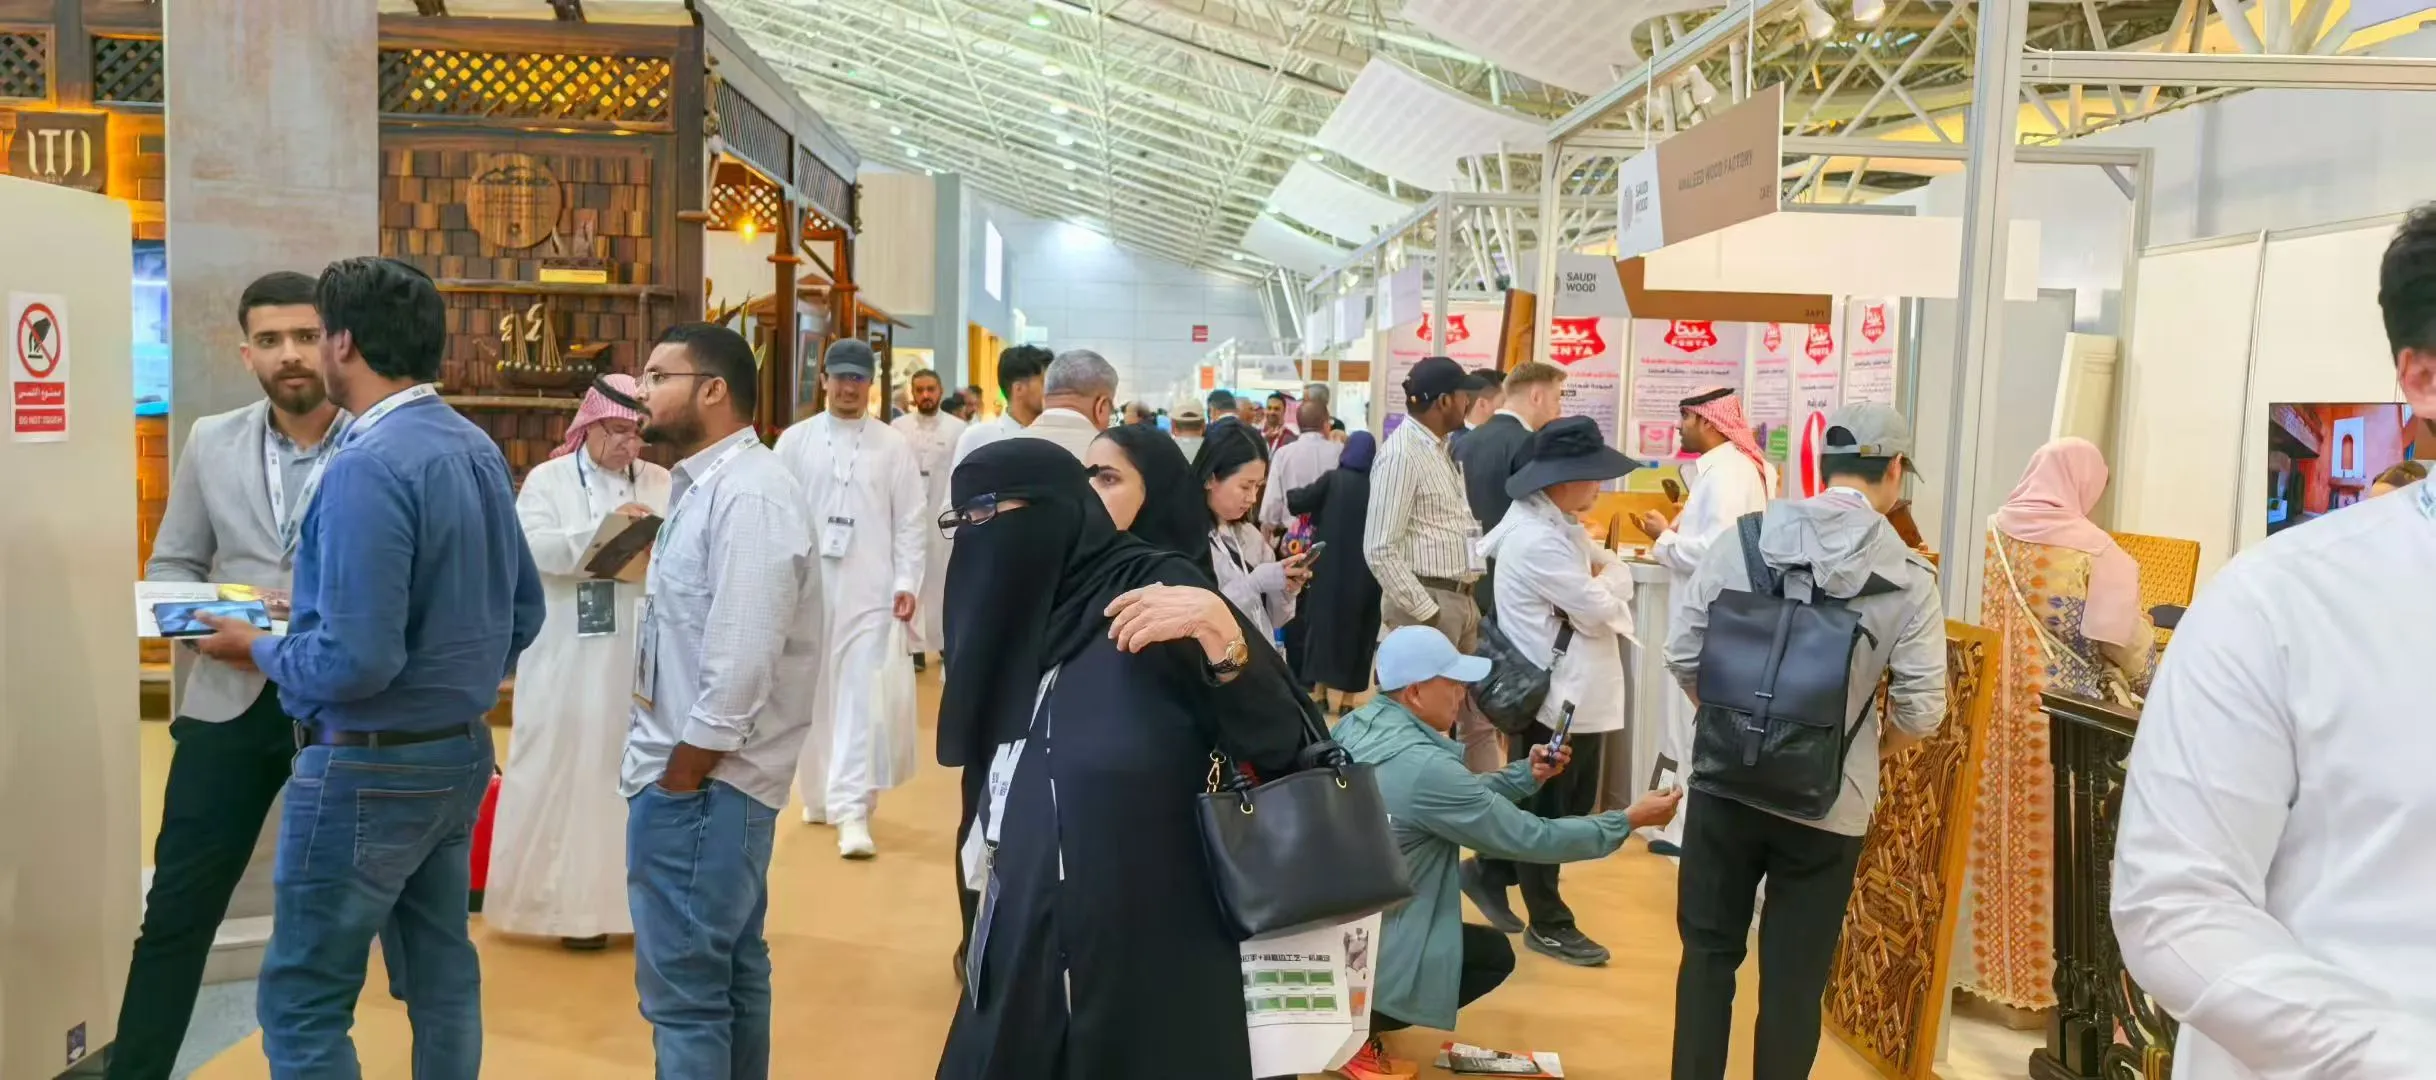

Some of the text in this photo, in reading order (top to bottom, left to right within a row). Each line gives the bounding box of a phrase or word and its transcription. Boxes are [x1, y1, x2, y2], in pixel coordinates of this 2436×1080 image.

[1566, 272, 1597, 282] SAUDI
[1566, 282, 1596, 293] WOOD
[19, 416, 28, 425] DO
[29, 416, 41, 425] NOT
